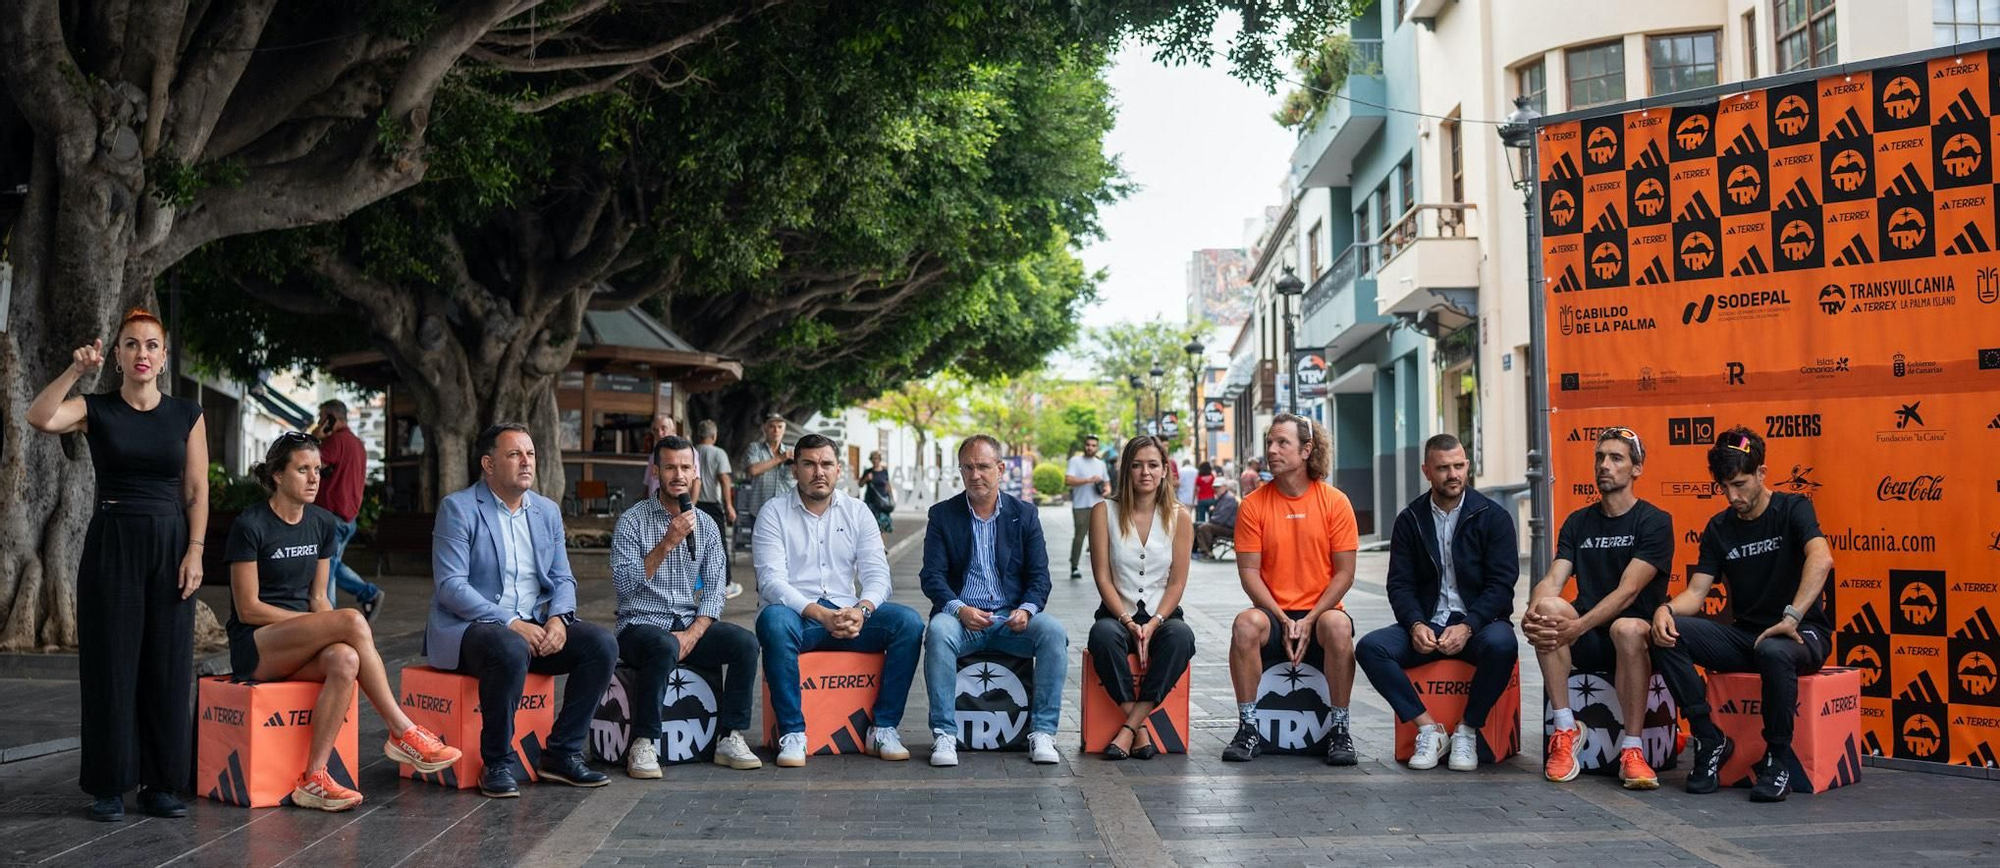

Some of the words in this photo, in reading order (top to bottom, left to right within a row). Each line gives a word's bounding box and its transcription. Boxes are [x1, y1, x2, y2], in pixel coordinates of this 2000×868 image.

[1945, 62, 1980, 77] TERREX
[1833, 82, 1865, 95] TERREX
[1731, 101, 1760, 112] TERREX
[1883, 97, 1921, 119] TRV
[1638, 117, 1663, 128] TERREX
[1775, 116, 1810, 136] TRV
[1552, 131, 1577, 142] TERREX
[1677, 132, 1709, 151] TRV
[1891, 138, 1924, 151] TERREX
[1587, 145, 1618, 165] TRV
[1784, 153, 1814, 166] TERREX
[1682, 168, 1711, 179] TERREX
[1942, 154, 1982, 177] TRV
[1595, 181, 1621, 192] TERREX
[1830, 170, 1867, 192] TRV
[1727, 185, 1761, 205] TRV
[1952, 196, 1986, 209] TERREX
[1634, 197, 1665, 217] TRV
[1550, 207, 1575, 227] TRV
[1839, 210, 1870, 222] TERREX
[1737, 223, 1765, 235] TERREX
[1642, 234, 1668, 245] TERREX
[1888, 228, 1926, 251] TRV
[1557, 243, 1579, 253] TERREX
[1780, 240, 1815, 261] TRV
[1681, 250, 1715, 271] TRV
[1591, 260, 1622, 280] TRV
[1850, 275, 1956, 299] TRANSVULCANIA
[1717, 290, 1791, 309] SODEPAL
[1863, 300, 1897, 312] TERREX
[1900, 299, 1908, 310] LA
[1909, 297, 1931, 309] PALMA
[1932, 295, 1956, 307] ISLAND
[1575, 306, 1628, 321] CABILDO
[1819, 301, 1846, 315] TRV
[1576, 323, 1591, 335] DE
[1594, 321, 1610, 333] LA
[1613, 318, 1656, 332] PALMA
[1800, 366, 1835, 374] Canarias
[1816, 358, 1835, 366] Islas
[1907, 360, 1937, 368] Gobierno
[1298, 369, 1327, 384] TRV
[1674, 424, 1686, 440] H
[1695, 423, 1712, 439] 10
[1766, 414, 1822, 438] 226ERS
[1876, 434, 1913, 443] Fundación
[1573, 483, 1598, 495] FRED.
[1672, 484, 1711, 494] SPAR
[1876, 475, 1946, 502] Coca-Cola
[1595, 535, 1635, 549] TERREX
[284, 544, 318, 558] TERREX
[1850, 579, 1883, 589] TERREX
[1962, 582, 1998, 593] TERREX
[1900, 605, 1938, 626] TRV
[1907, 646, 1940, 657] TERREX
[819, 674, 876, 690] TERREX
[1860, 667, 1882, 687] RV
[1957, 674, 1998, 696] TRV
[1426, 681, 1473, 695] TERRE
[416, 694, 453, 714] TERREX
[1830, 694, 1858, 715] TERREX
[213, 706, 245, 727] TERREX
[1255, 709, 1333, 750] TRV
[590, 718, 631, 762] TRV
[1902, 735, 1941, 757] TRV
[399, 739, 425, 761] TERREX
